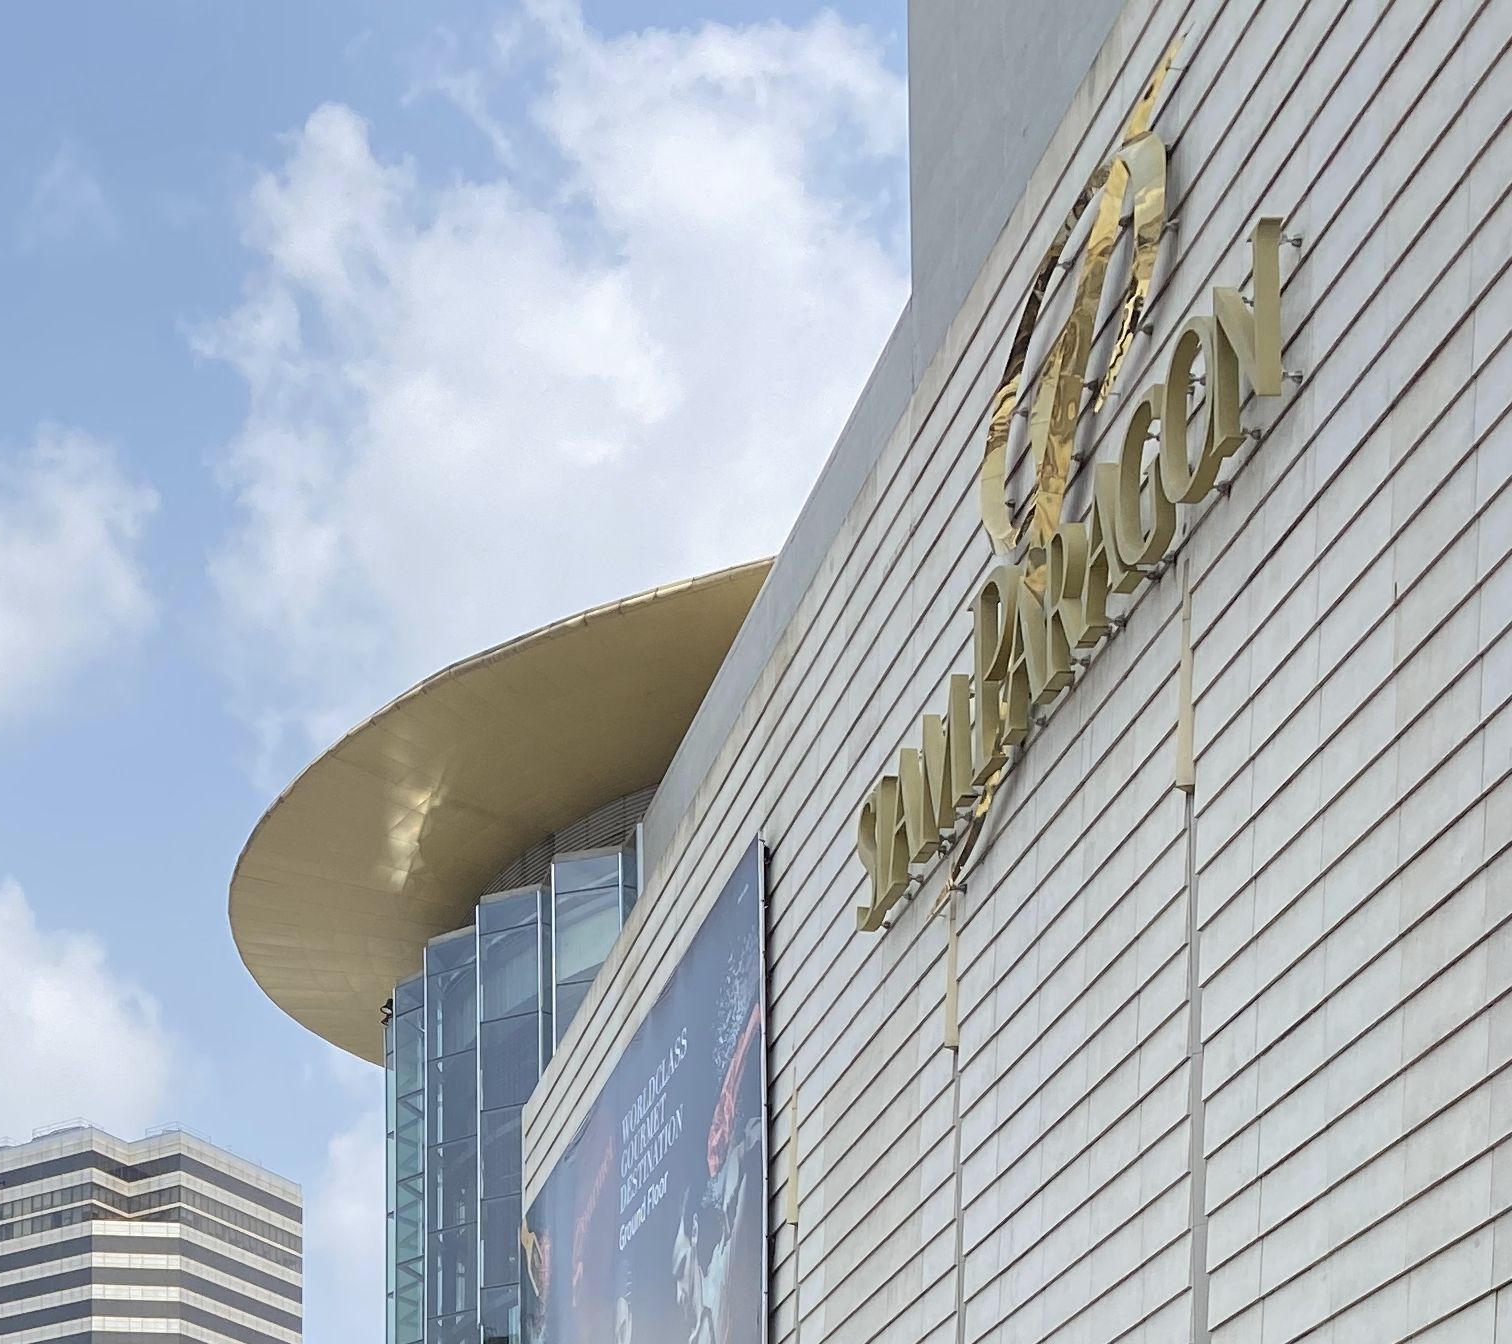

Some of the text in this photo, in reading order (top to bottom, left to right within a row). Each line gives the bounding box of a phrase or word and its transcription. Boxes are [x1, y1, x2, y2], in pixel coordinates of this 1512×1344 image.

[857, 217, 1282, 932] SIAM PARAGON
[619, 1104, 684, 1215] DESTINATION
[620, 1093, 666, 1178] GOURMET
[619, 1170, 669, 1250] Ground Floor
